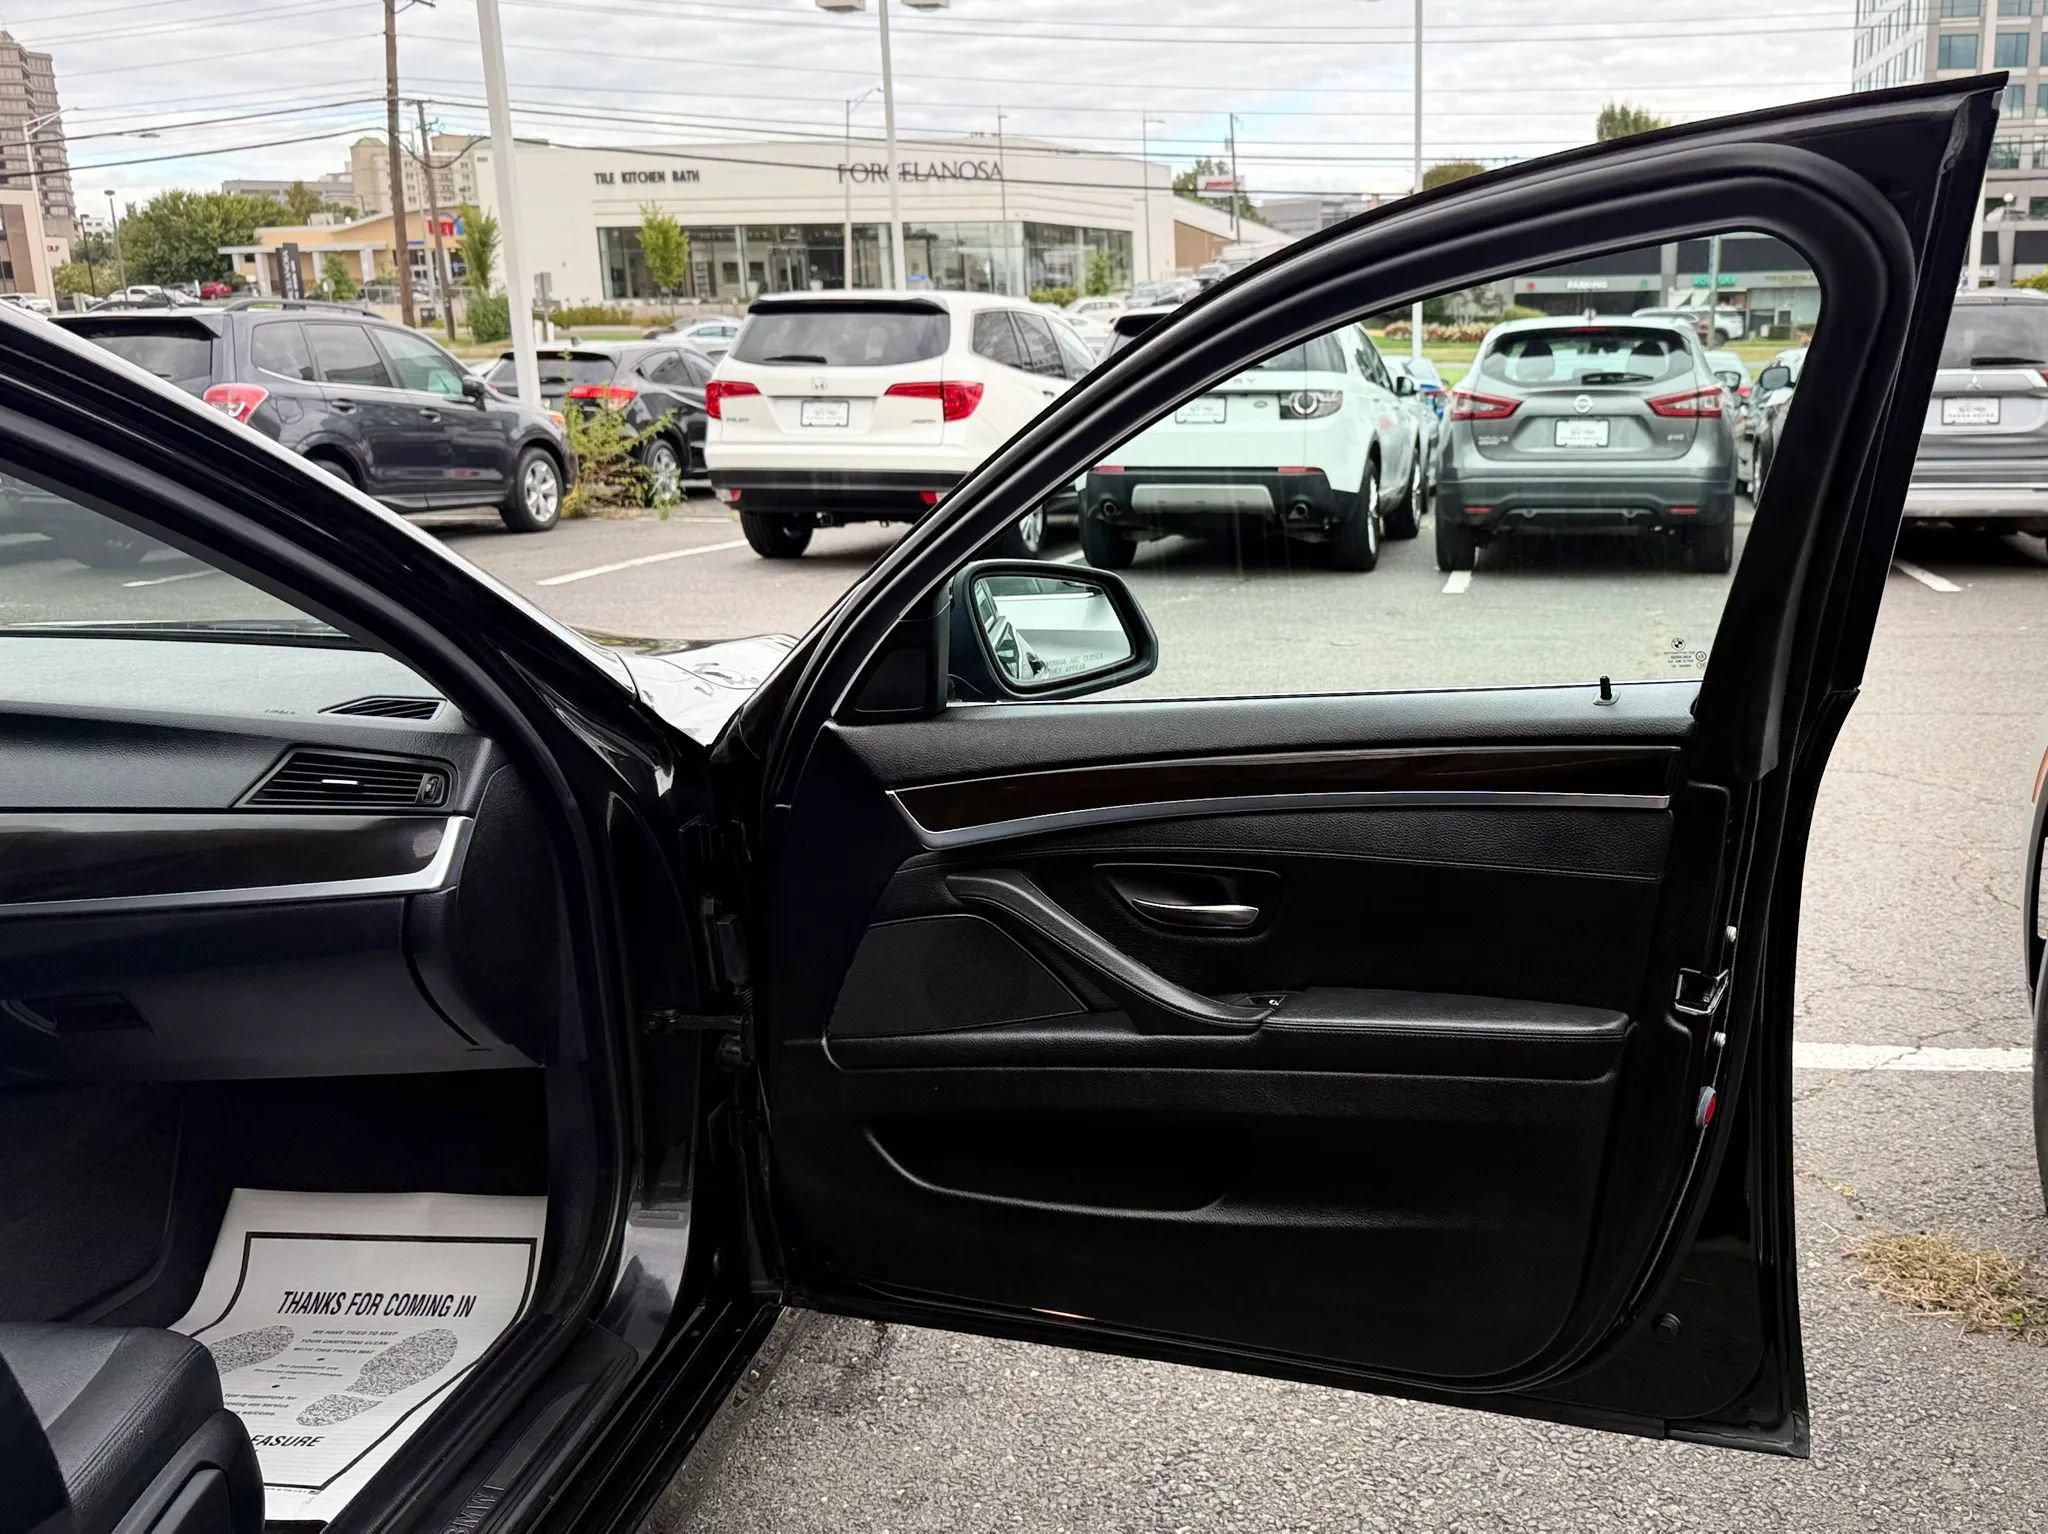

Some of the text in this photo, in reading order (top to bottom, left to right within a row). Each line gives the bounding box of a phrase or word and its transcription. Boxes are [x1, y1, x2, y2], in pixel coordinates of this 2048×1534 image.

[594, 170, 700, 184] TILE KITCHEN BATH
[277, 1291, 478, 1318] THANKS FOR COMING IN
